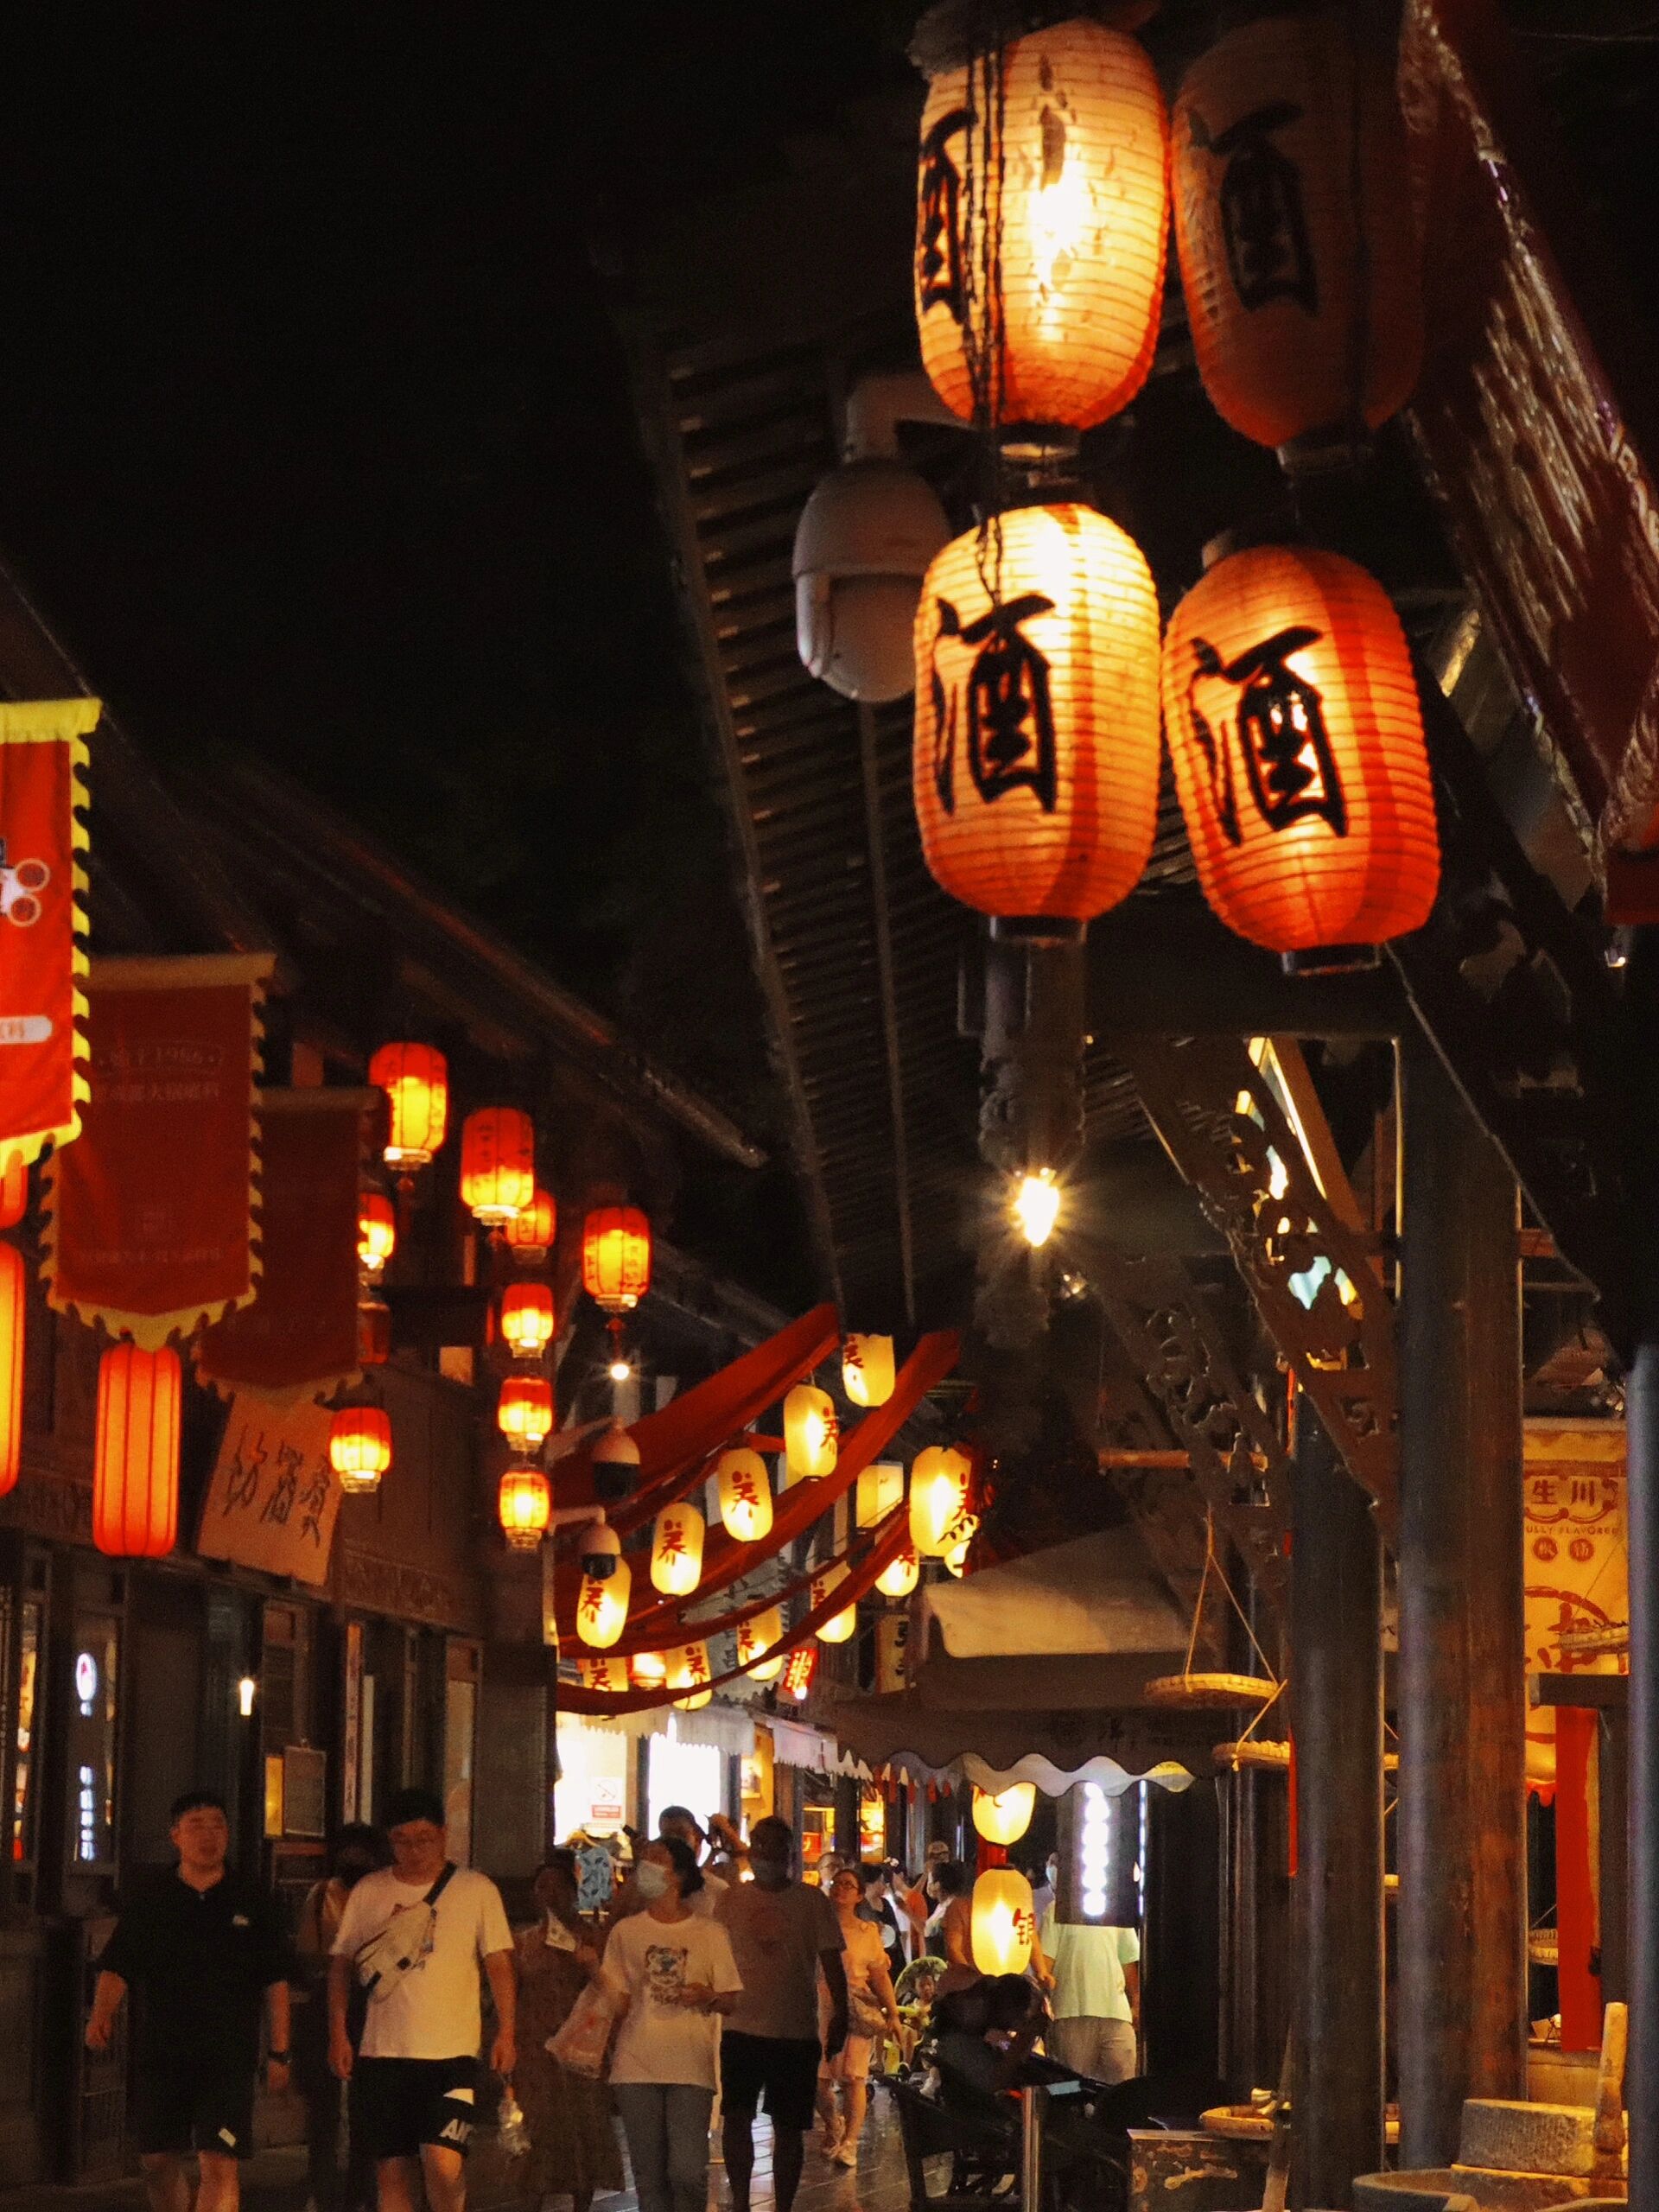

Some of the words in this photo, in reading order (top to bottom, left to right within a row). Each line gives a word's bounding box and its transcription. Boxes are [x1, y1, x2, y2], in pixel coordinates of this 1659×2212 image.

[1184, 100, 1320, 327] 酒
[935, 591, 1057, 816] 酒
[1192, 626, 1348, 845] 酒
[1531, 1478, 1596, 1506] 生川
